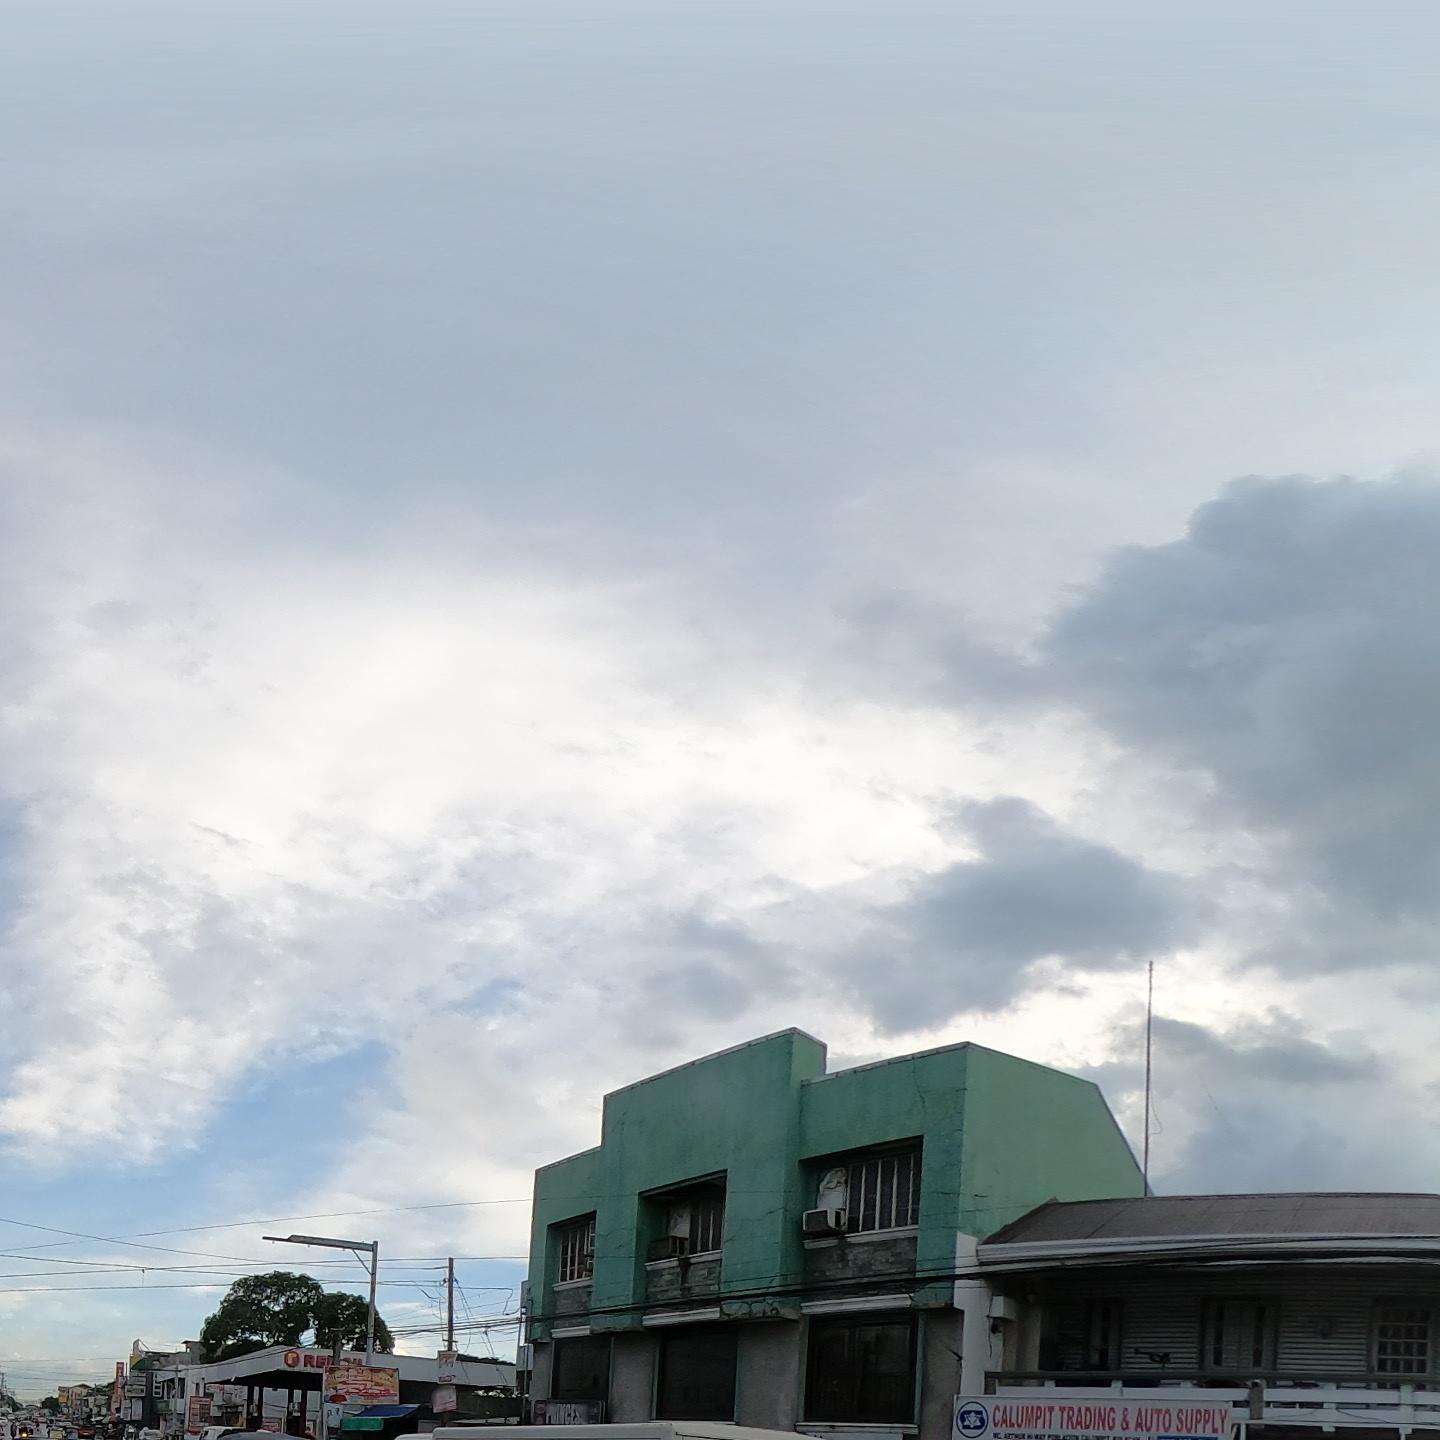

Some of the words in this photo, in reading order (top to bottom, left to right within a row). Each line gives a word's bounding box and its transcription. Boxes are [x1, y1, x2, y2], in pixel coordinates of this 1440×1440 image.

[992, 1404, 1056, 1429] CALUMPIT
[1059, 1406, 1116, 1431] TRADING
[1120, 1407, 1129, 1431] &
[1134, 1408, 1171, 1432] AUTO
[1176, 1408, 1228, 1434] SUPPLY
